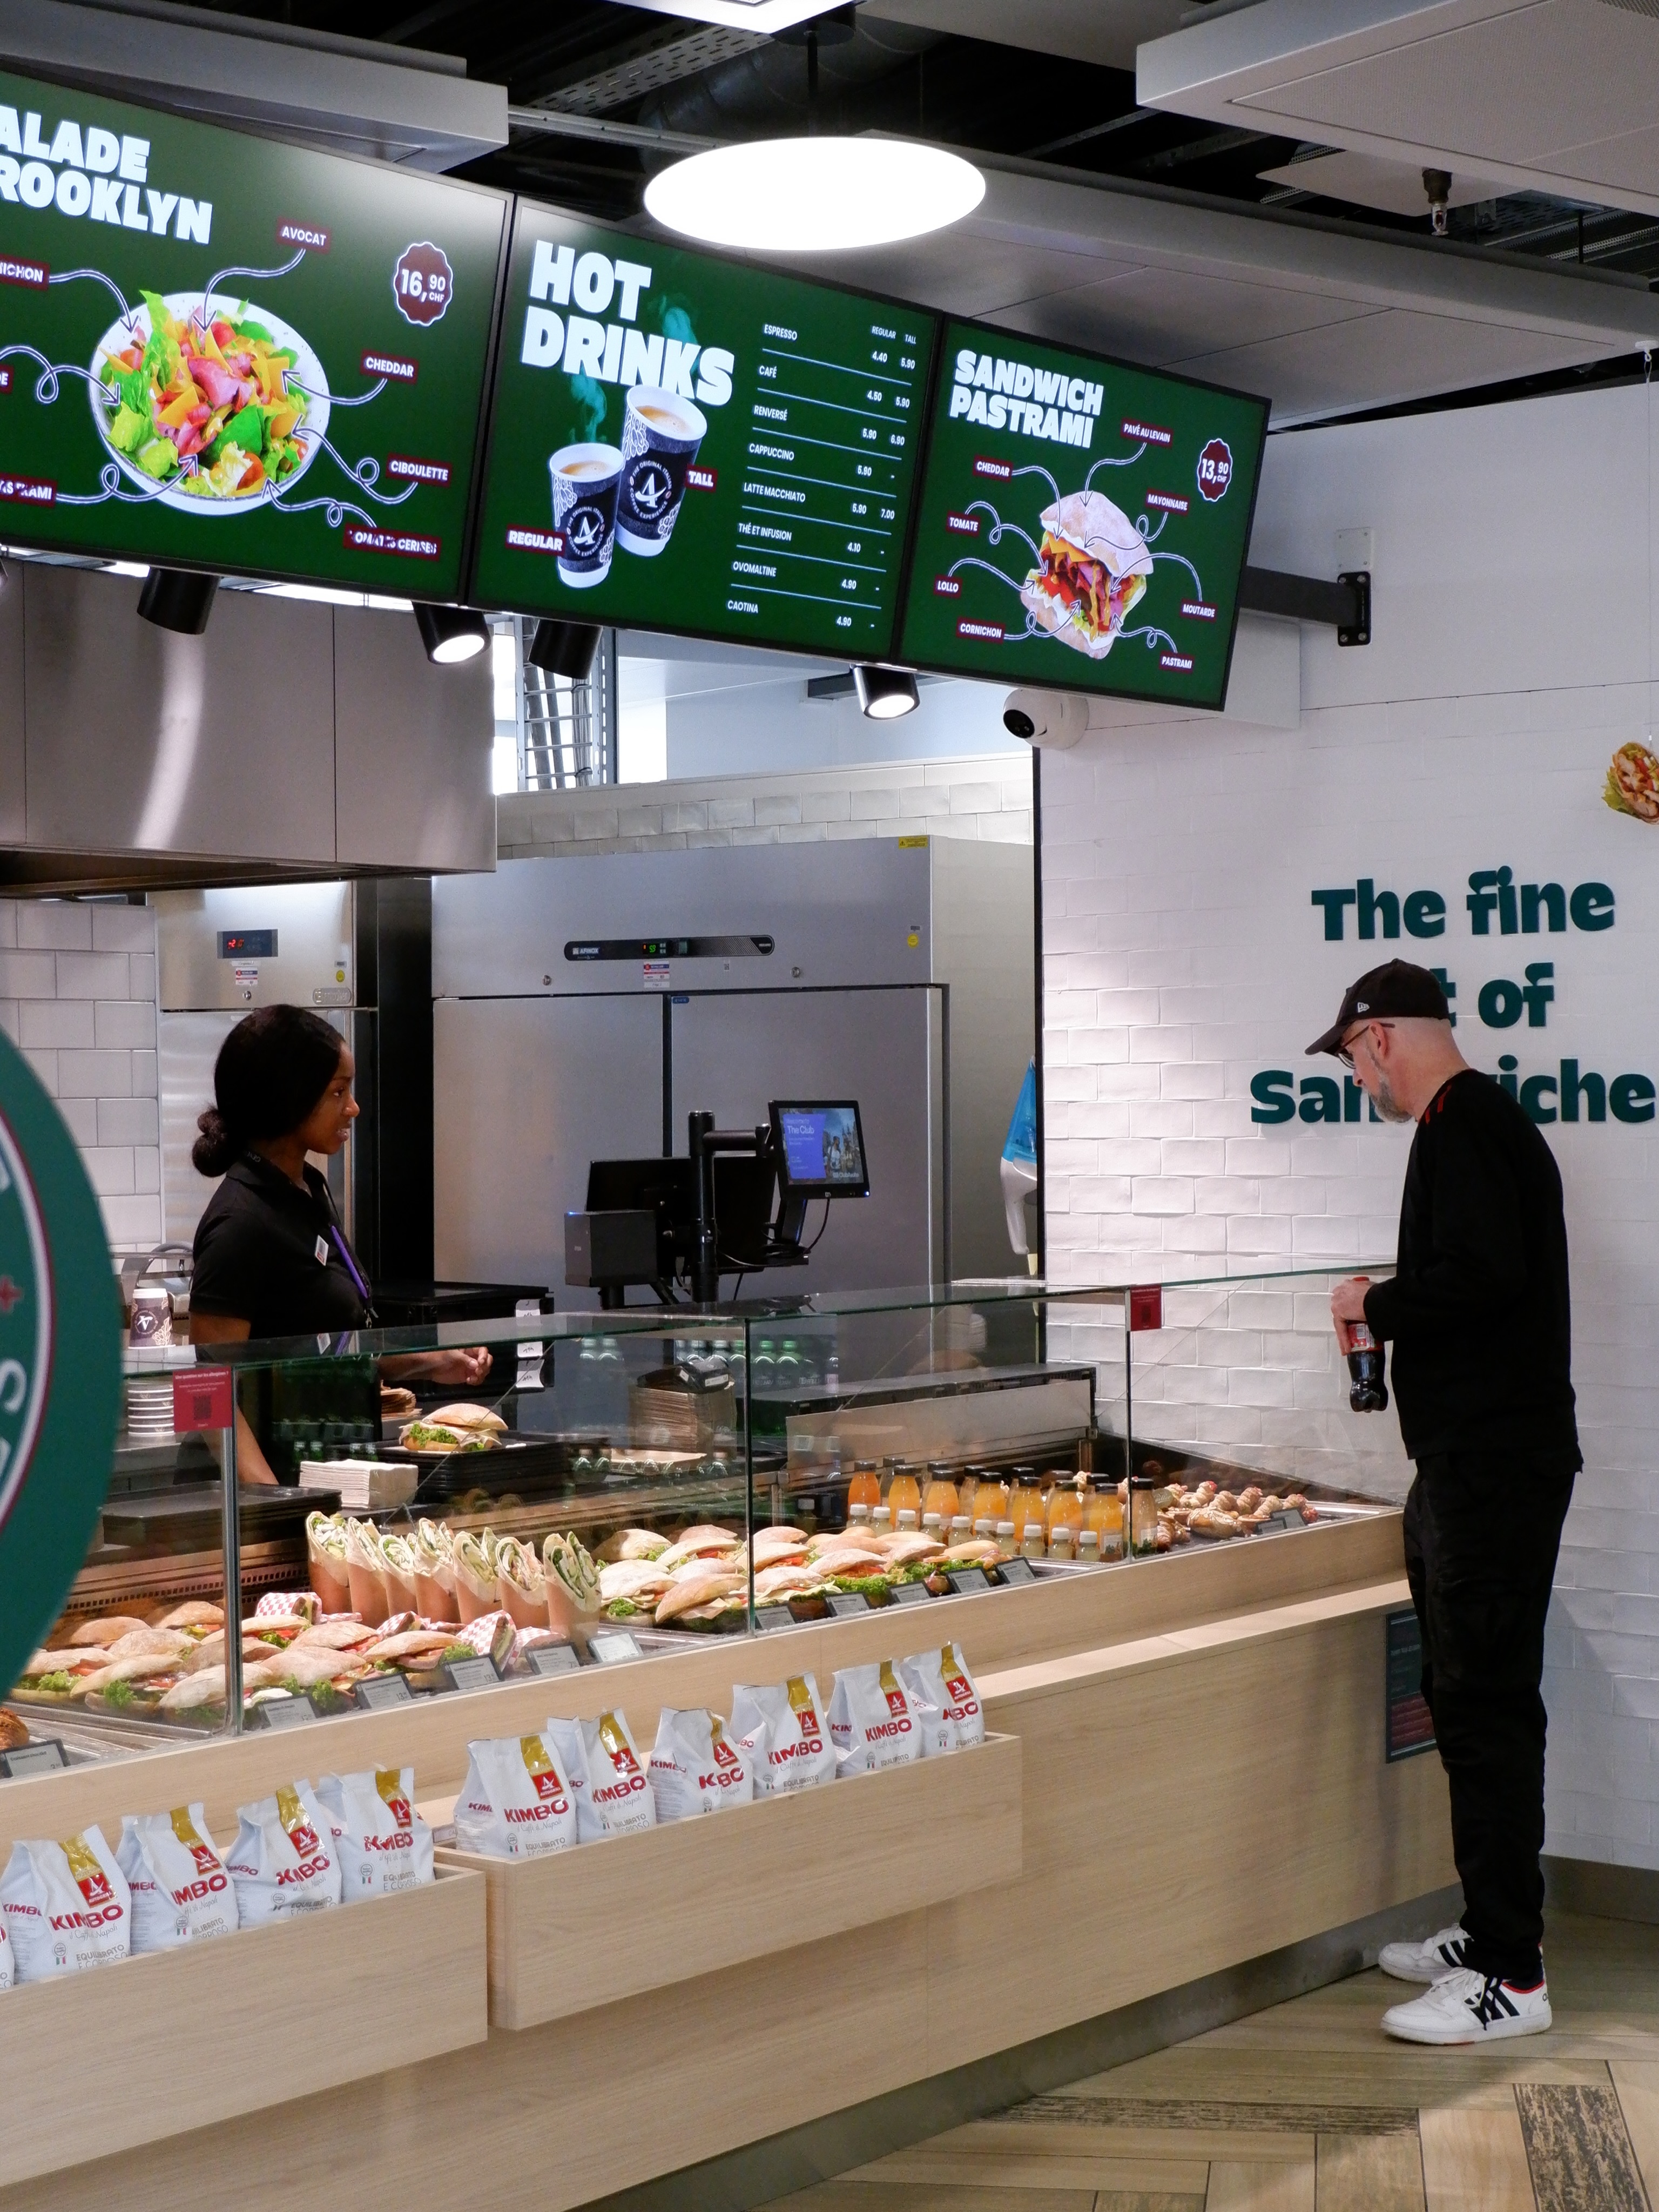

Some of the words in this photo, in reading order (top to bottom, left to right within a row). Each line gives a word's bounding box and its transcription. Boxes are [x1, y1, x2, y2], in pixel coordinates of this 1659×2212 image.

[282, 226, 326, 246] AVOCAT
[529, 240, 651, 321] HOT
[429, 292, 444, 302] CHF
[764, 324, 797, 340] ESPRESSO
[872, 351, 887, 362] 4.40
[901, 358, 915, 369] 5.90
[872, 326, 896, 339] REGULAR
[905, 334, 916, 344] TALL
[366, 357, 414, 377] CHEDDAR
[521, 306, 734, 406] DRINKS
[759, 366, 777, 378] CAFÉ
[867, 390, 882, 401] 4.50
[896, 396, 910, 408] 5.90
[954, 350, 1104, 416] SANDWICH
[754, 405, 787, 421] RENVERSÉ
[863, 428, 876, 440] 5.90
[891, 434, 905, 446] 6.90
[949, 386, 1094, 448] PASTRAMI
[1124, 423, 1140, 435] PAVÉ
[1141, 428, 1149, 437] AU
[1149, 430, 1170, 442] LEVAIN
[390, 460, 448, 481] CIBOULETTE
[749, 443, 794, 461] CAPPUCCINO
[858, 465, 872, 476] 5.90
[976, 461, 1010, 477] CHEDDAR
[689, 471, 713, 487] TALL
[744, 482, 763, 495] LATTE
[764, 487, 805, 502] MACCHIATO
[852, 503, 866, 514] 5.90
[881, 509, 894, 519] 7.00
[1148, 494, 1188, 510] MAYONNAISE
[949, 517, 978, 532] TOMATE
[508, 530, 563, 551] REGULAR
[739, 522, 751, 534] THÉ
[752, 525, 760, 535] ET
[761, 527, 792, 541] INFUSION
[847, 542, 860, 552] 4.10
[733, 561, 777, 577] OVOMALTINE
[841, 579, 857, 590] 4.90
[937, 580, 959, 593] LOLLO
[727, 600, 758, 613] CAOTINA
[837, 616, 852, 626] 4.90
[1182, 604, 1215, 618] MOUTARDE
[960, 623, 1002, 638] CORNICHON
[1162, 656, 1192, 669] PASTRAMI
[1311, 879, 1446, 941] The
[1466, 866, 1615, 935] fine
[1478, 962, 1554, 1028] of
[787, 1125, 799, 1134] The
[800, 1125, 814, 1134] Club
[865, 1718, 912, 1742] KIMBO
[767, 1739, 823, 1765] KIMBO
[699, 1767, 744, 1789] KBO
[504, 1798, 569, 1823] KIMBO
[542, 1819, 562, 1830] Napoli
[171, 1873, 227, 1905] IMBO
[49, 1904, 124, 1931] KIMBO
[96, 1923, 118, 1938] Napoli
